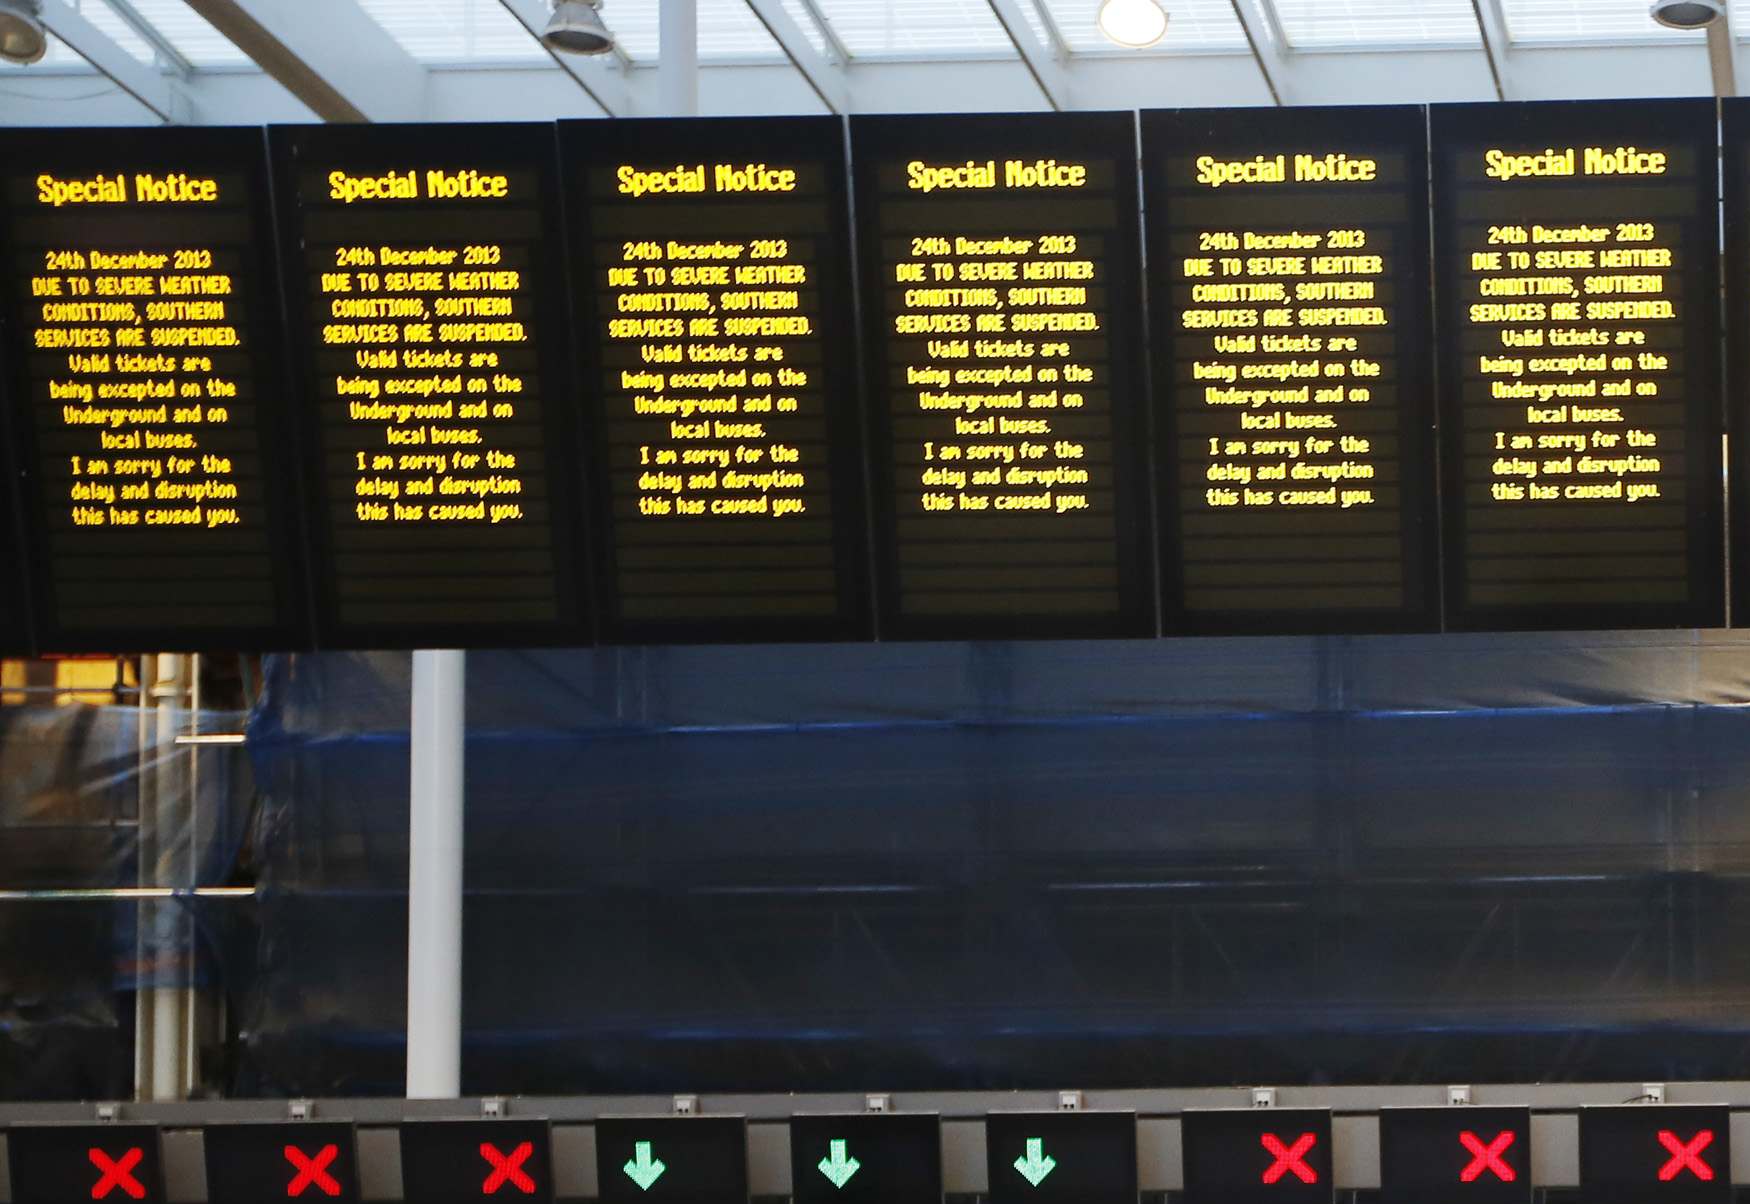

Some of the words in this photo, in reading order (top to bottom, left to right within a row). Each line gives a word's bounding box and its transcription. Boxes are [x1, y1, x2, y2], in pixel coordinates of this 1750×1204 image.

[908, 161, 995, 192] Special
[1005, 160, 1085, 187] Notice
[1197, 155, 1285, 186] Special
[1295, 155, 1375, 180] Notice
[1486, 149, 1574, 179] Special
[1584, 147, 1665, 174] Notice
[37, 175, 126, 206] Special
[135, 174, 217, 201] Notice
[329, 171, 417, 203] Special
[427, 170, 507, 198] Notice
[617, 165, 705, 197] Special
[715, 164, 795, 191] Notice
[1200, 233, 1239, 250] 24th
[1244, 232, 1322, 250] December
[1327, 230, 1365, 248] 2013
[46, 251, 86, 270] 24th
[90, 251, 169, 269] December
[173, 250, 212, 269] 2013
